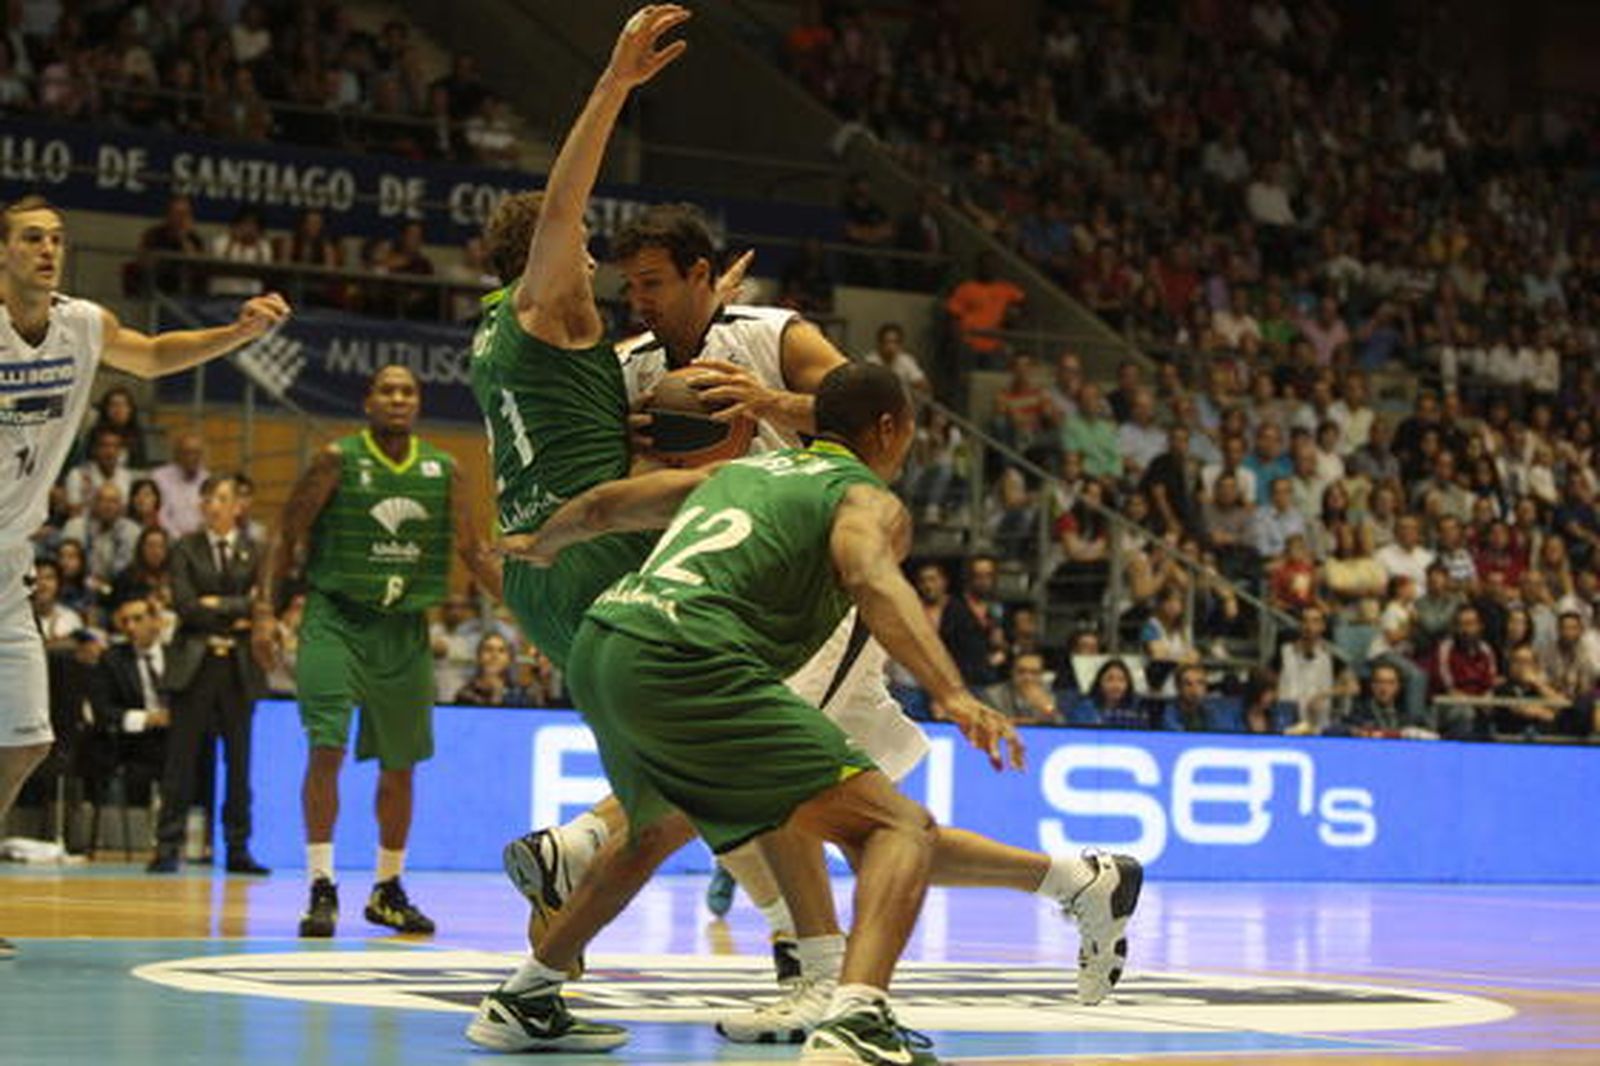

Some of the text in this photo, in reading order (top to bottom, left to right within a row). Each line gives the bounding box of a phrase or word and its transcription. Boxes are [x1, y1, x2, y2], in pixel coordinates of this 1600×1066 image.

[97, 144, 148, 192] DE
[172, 153, 355, 210] SANTIAGO
[378, 175, 427, 218] DE
[638, 505, 753, 586] 12
